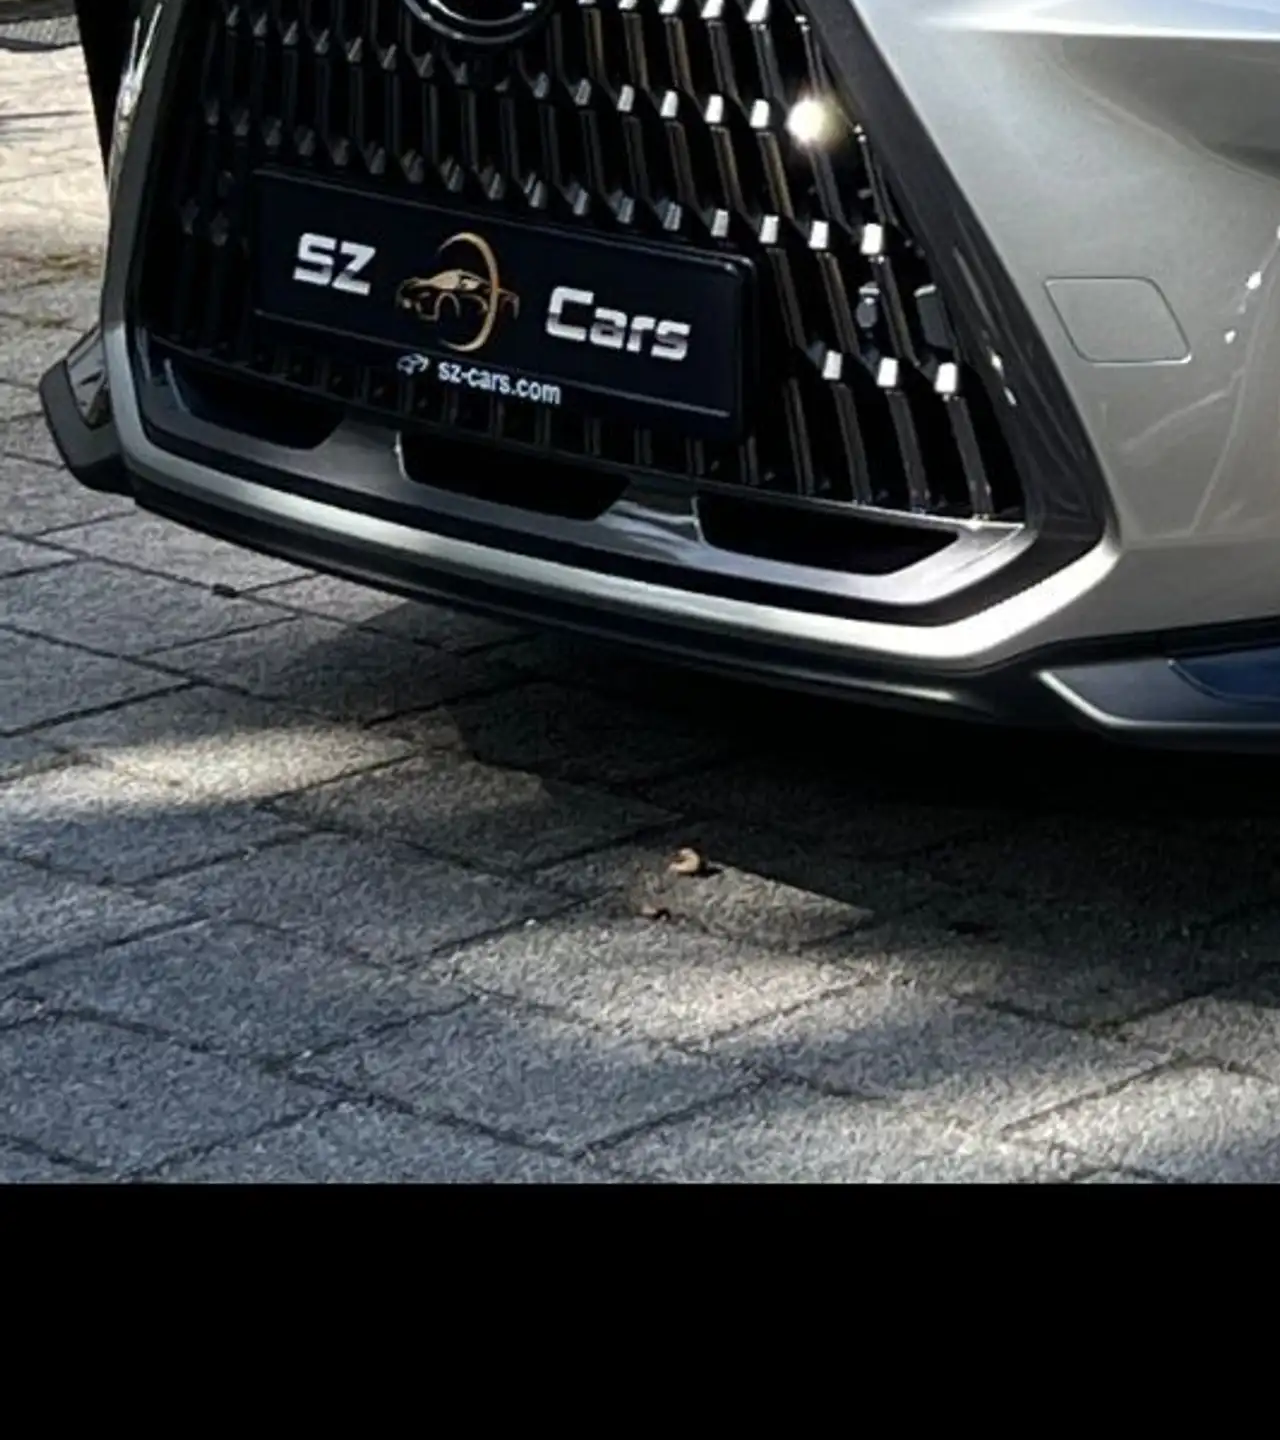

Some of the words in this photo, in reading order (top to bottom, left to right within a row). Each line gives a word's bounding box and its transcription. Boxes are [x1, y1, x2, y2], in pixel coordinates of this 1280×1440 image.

[292, 232, 377, 296] SZ
[545, 285, 691, 361] Cars
[437, 359, 562, 405] sz-cars.com
